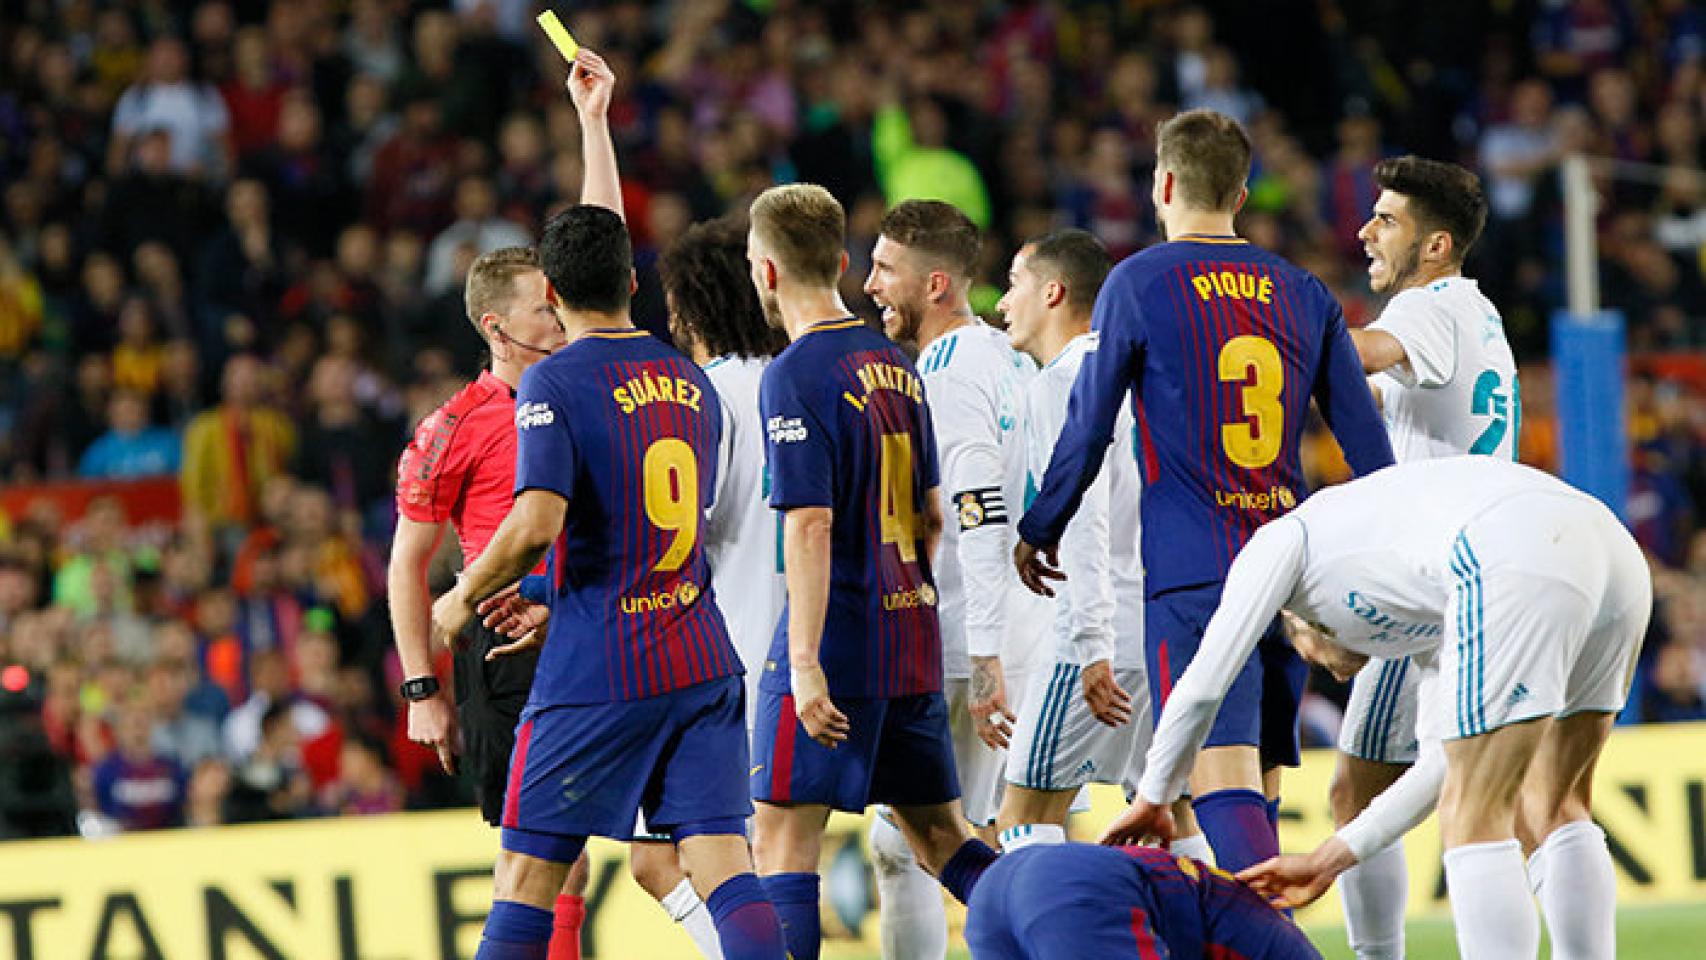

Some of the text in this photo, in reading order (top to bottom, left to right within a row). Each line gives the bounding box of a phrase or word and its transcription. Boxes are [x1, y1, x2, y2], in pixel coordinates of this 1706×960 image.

[1192, 272, 1273, 304] PIQUÉ
[613, 369, 702, 414] SUÁREZ
[1218, 334, 1285, 469] 3
[1468, 368, 1522, 463] 2
[643, 438, 698, 572] 9
[879, 432, 920, 563] 4
